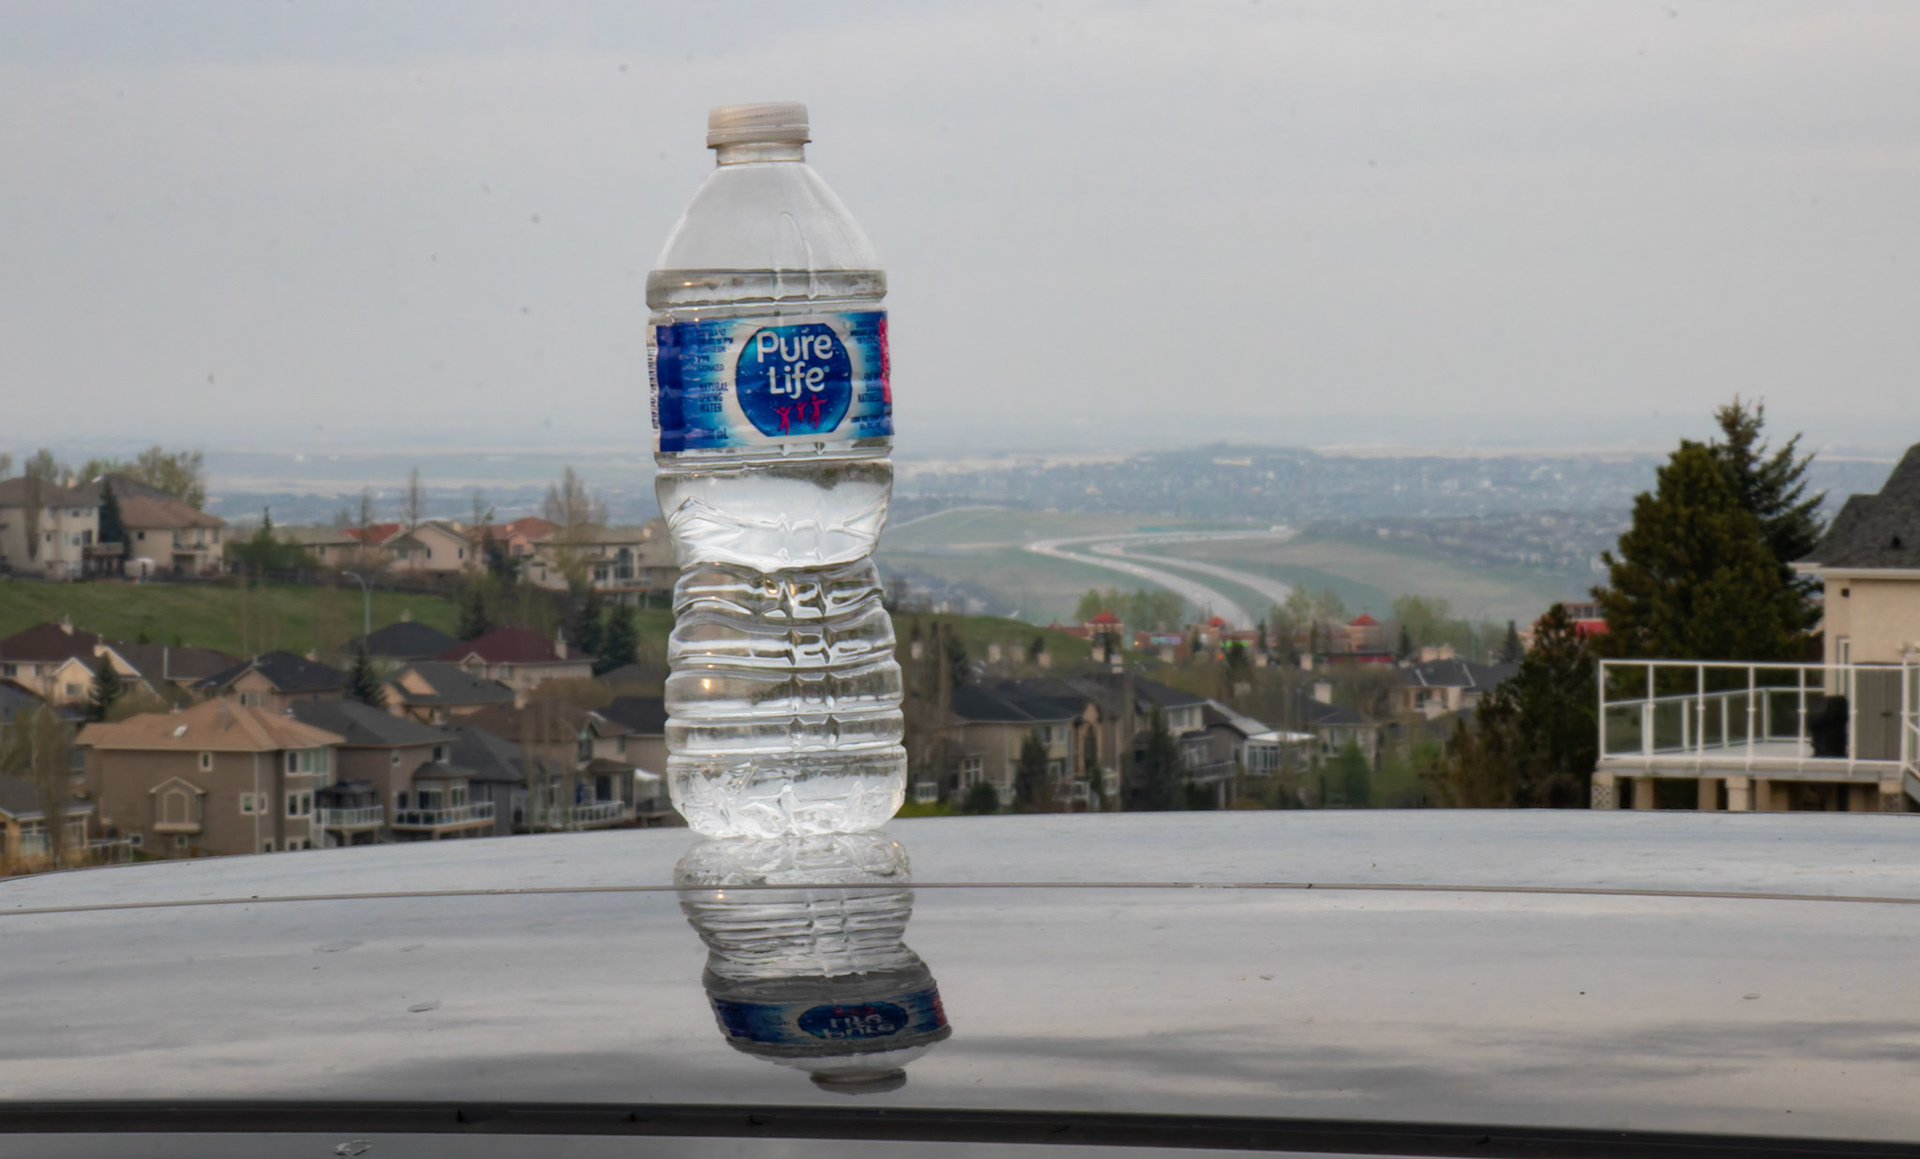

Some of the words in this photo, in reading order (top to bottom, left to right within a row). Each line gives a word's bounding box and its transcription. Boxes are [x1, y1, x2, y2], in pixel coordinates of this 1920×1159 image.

[756, 331, 834, 363] Pure
[699, 382, 729, 392] NATURAL
[769, 362, 825, 399] Life
[699, 403, 723, 413] WATER
